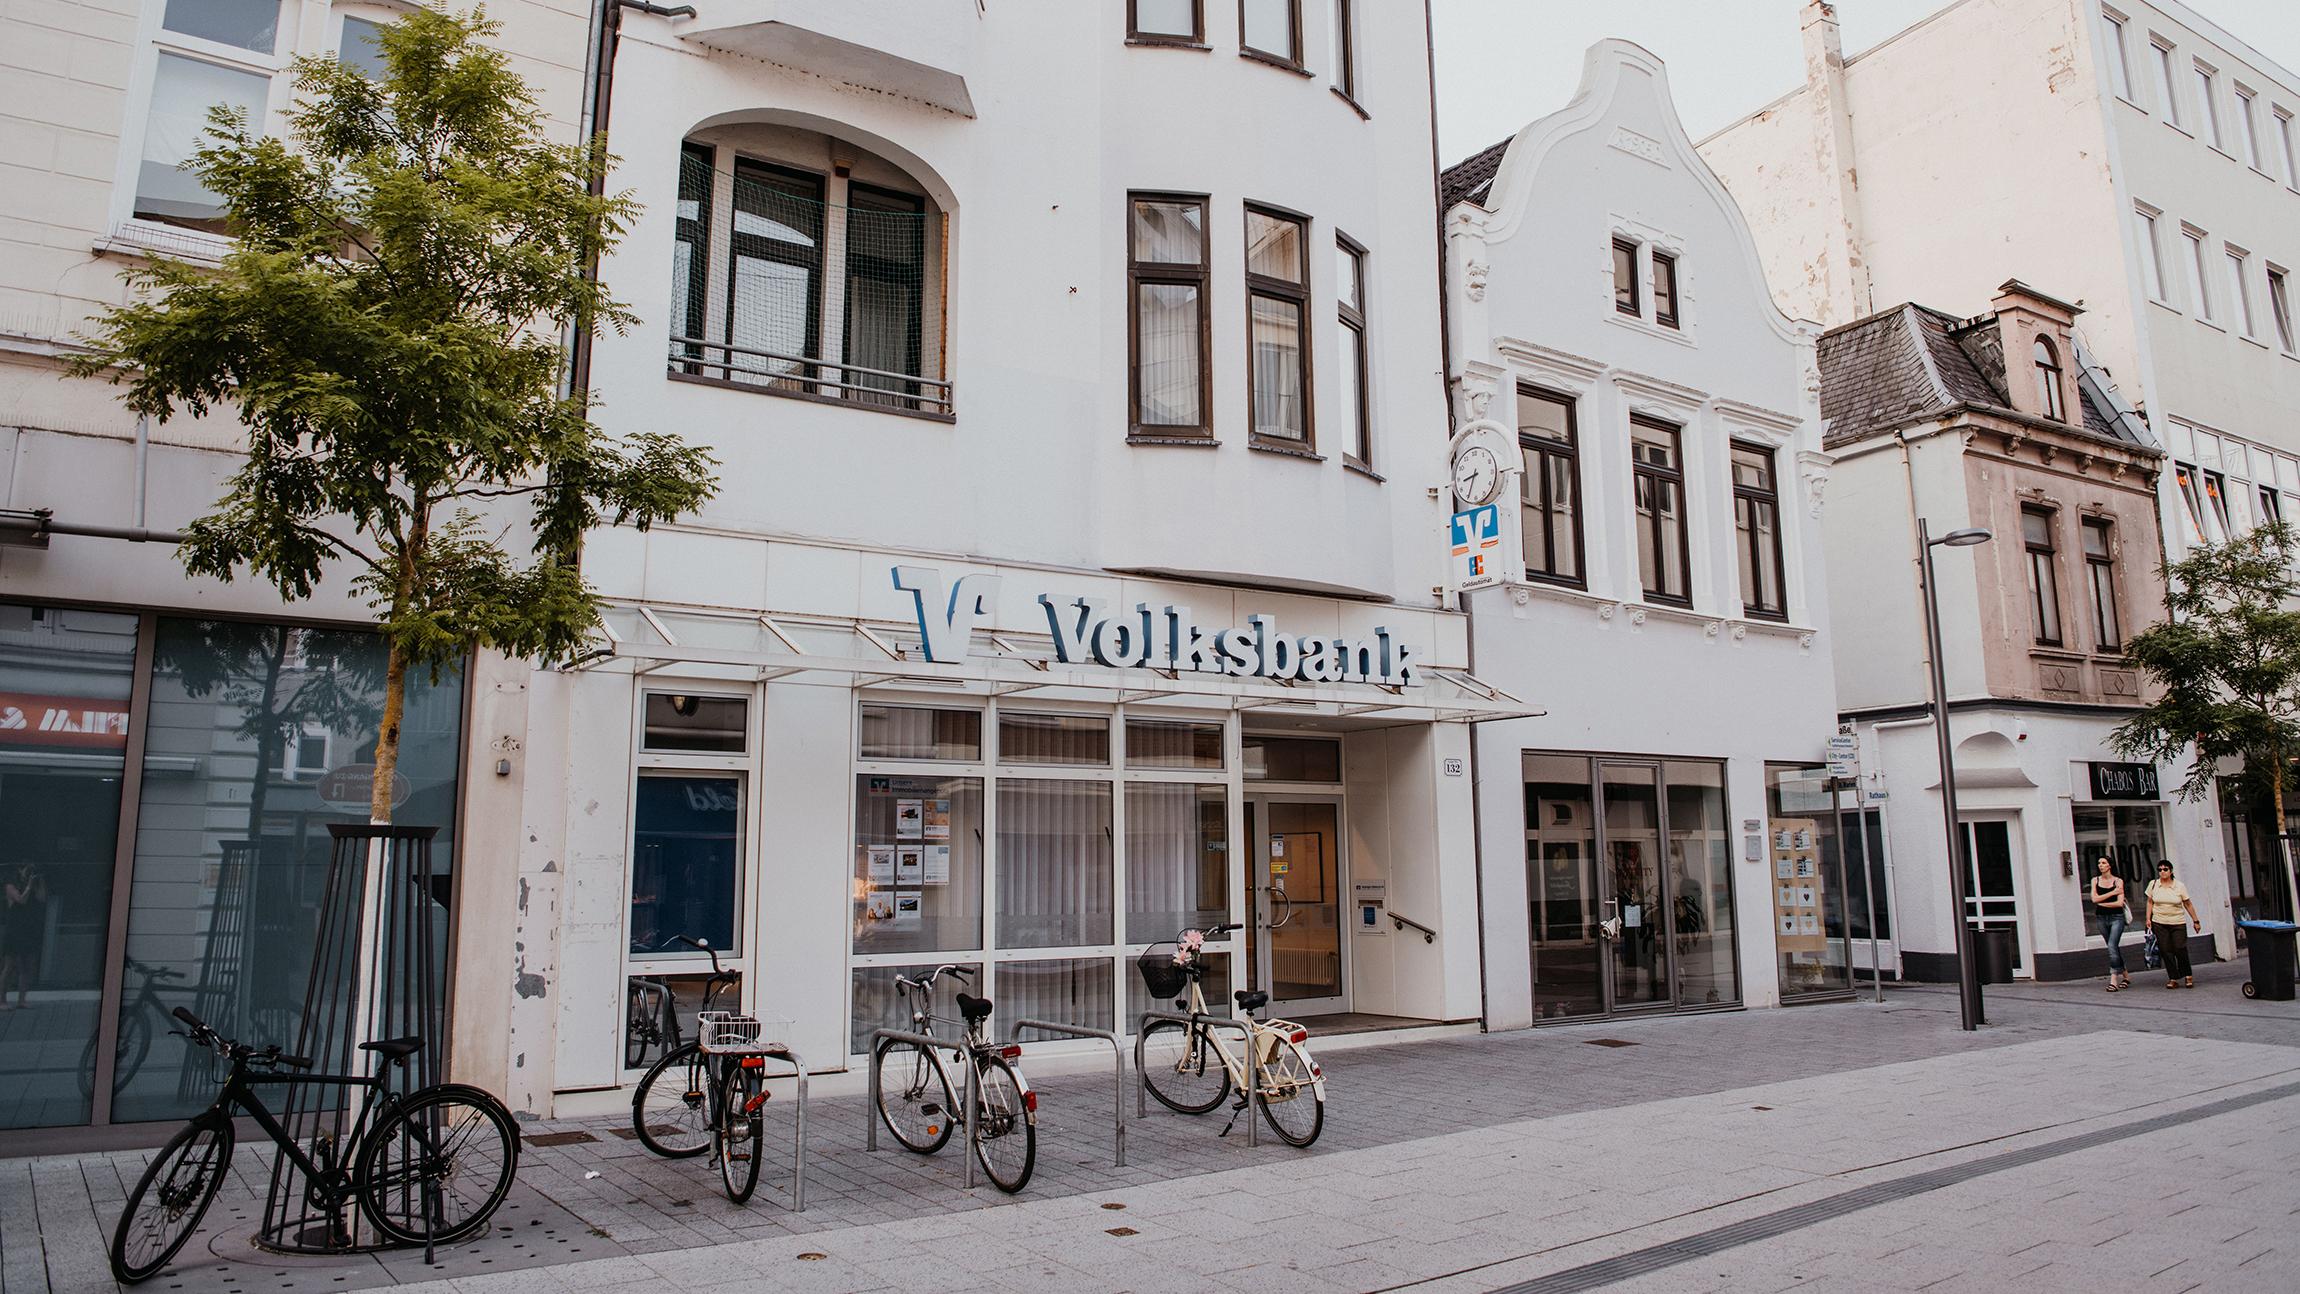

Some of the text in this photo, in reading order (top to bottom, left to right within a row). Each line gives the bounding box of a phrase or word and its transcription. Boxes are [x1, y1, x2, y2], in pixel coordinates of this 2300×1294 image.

[1037, 592, 1422, 686] Volksbank
[1446, 763, 1461, 774] 132
[2138, 767, 2157, 796] BAR
